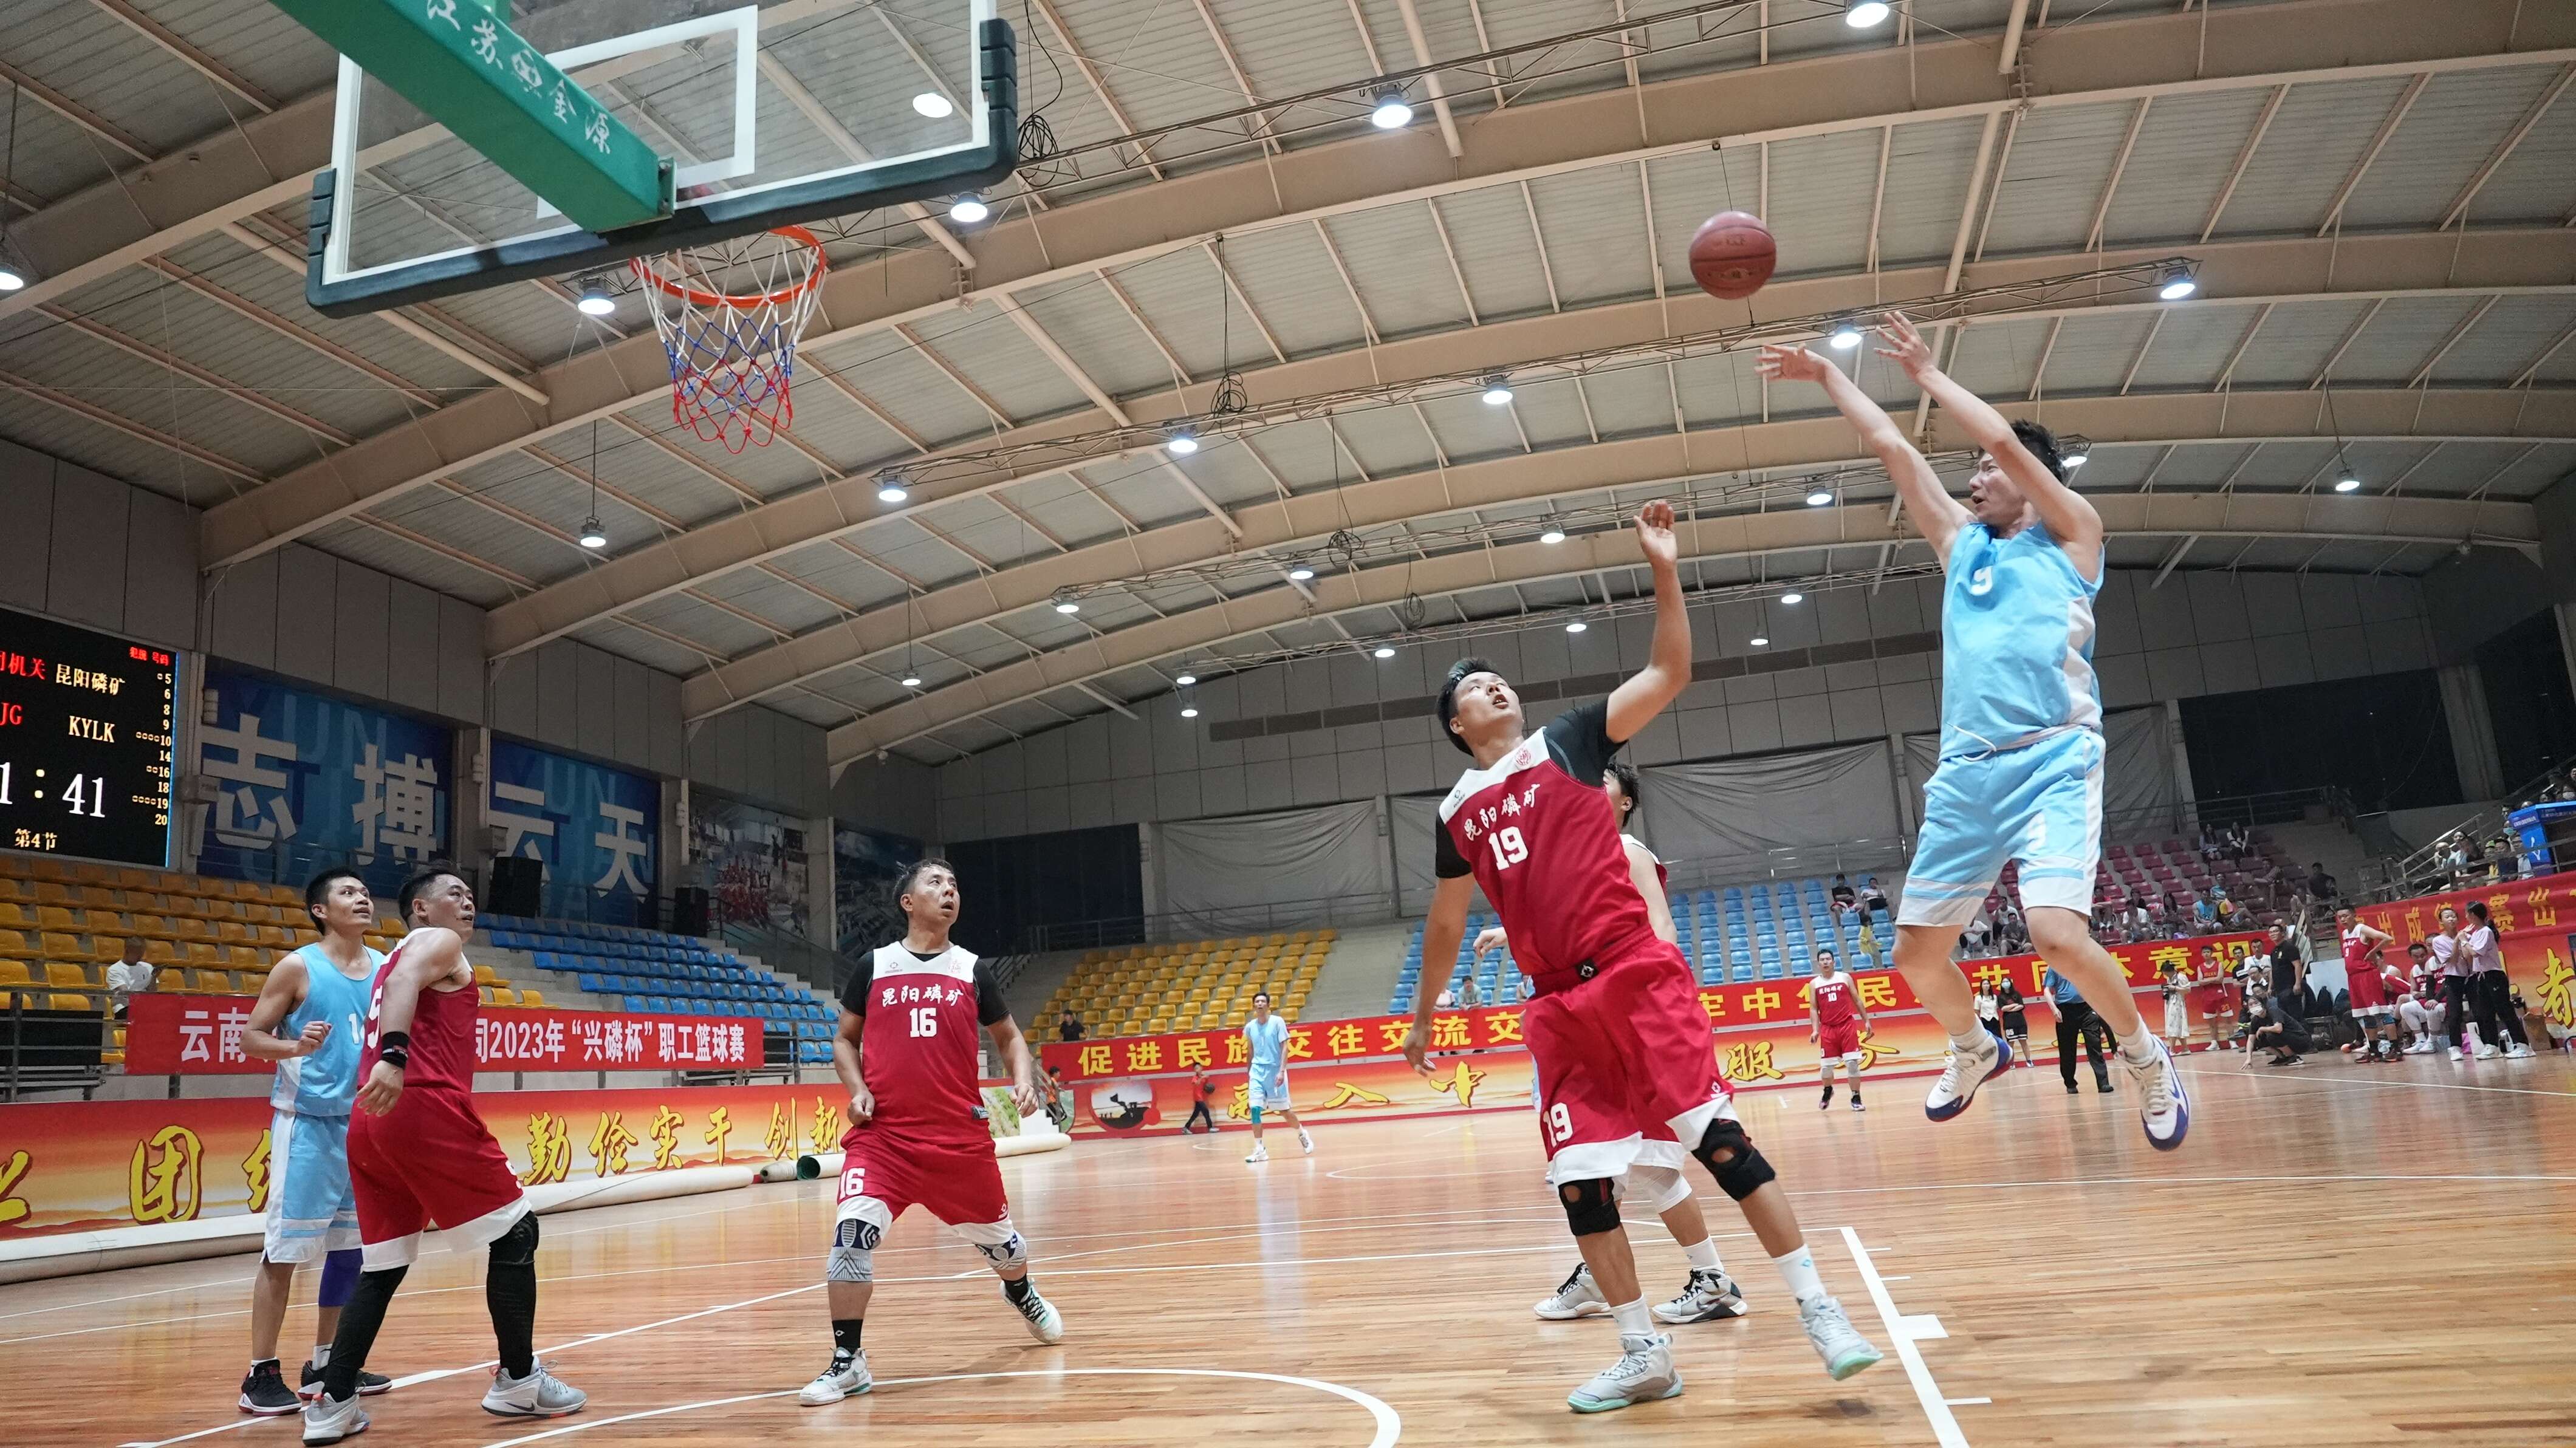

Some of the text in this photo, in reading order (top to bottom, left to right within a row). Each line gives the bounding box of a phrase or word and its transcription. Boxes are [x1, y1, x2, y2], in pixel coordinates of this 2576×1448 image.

[56, 663, 126, 695] 昆阳磷矿
[165, 673, 172, 685] 5
[164, 688, 171, 700] 6
[163, 704, 170, 715] 8
[68, 715, 115, 743] KYLK
[162, 719, 170, 731] 9
[160, 735, 171, 747] 10
[159, 750, 171, 762] 14
[158, 767, 170, 778] 16
[62, 773, 106, 818] 41
[157, 782, 170, 793] 18
[157, 797, 168, 810] 19
[1464, 784, 1541, 841] 昆阳磷矿
[155, 814, 167, 826] 20
[15, 828, 58, 851] 第4节
[1488, 825, 1529, 871] 19
[882, 984, 964, 1008] 昆阳磷矿
[1828, 992, 1837, 1002] 10
[348, 1013, 365, 1045] 1
[909, 1008, 937, 1037] 16
[1543, 1102, 1574, 1148] 19
[838, 1167, 866, 1200] 16
